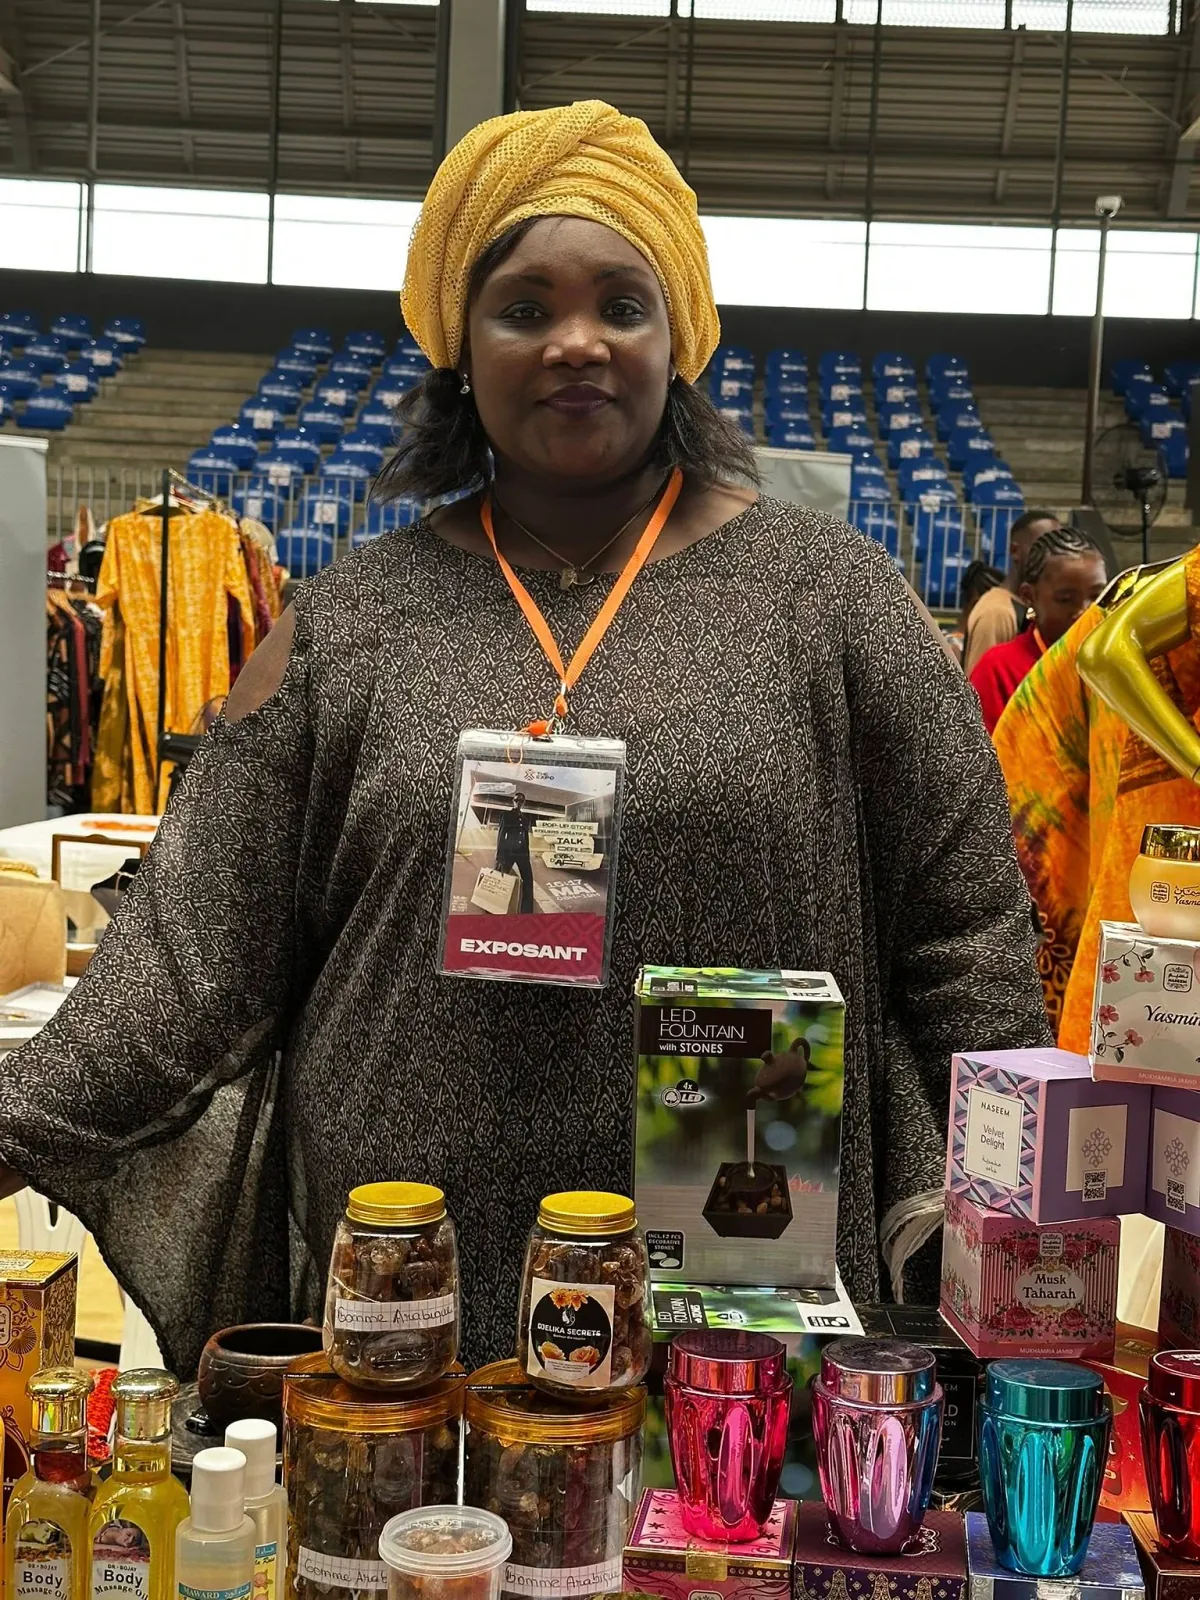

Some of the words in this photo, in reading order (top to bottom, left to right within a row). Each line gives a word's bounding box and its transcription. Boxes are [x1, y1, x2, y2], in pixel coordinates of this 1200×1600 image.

[556, 837, 584, 845] TALK
[549, 882, 597, 897] MAI
[460, 938, 588, 961] EXPOSANT
[660, 1008, 696, 1023] LED
[660, 1023, 745, 1040] FOUNTAIN
[659, 1043, 677, 1052] with
[680, 1043, 723, 1054] STONES
[682, 1081, 693, 1090] 4x
[681, 1093, 702, 1102] LED
[980, 1101, 1010, 1117] NASEEM
[983, 1123, 1005, 1139] Velvet
[980, 1134, 1005, 1151] Delight
[1034, 1273, 1067, 1285] Musk
[1022, 1286, 1077, 1299] Taharah
[337, 1306, 388, 1324] Gomme
[537, 1322, 566, 1334] DJELIKA
[566, 1328, 602, 1337] SECRETS
[23, 1571, 63, 1589] Body
[104, 1569, 143, 1589] Body
[17, 1585, 53, 1597] Massage
[94, 1584, 133, 1595] Massage
[183, 1585, 220, 1599] MAWARD
